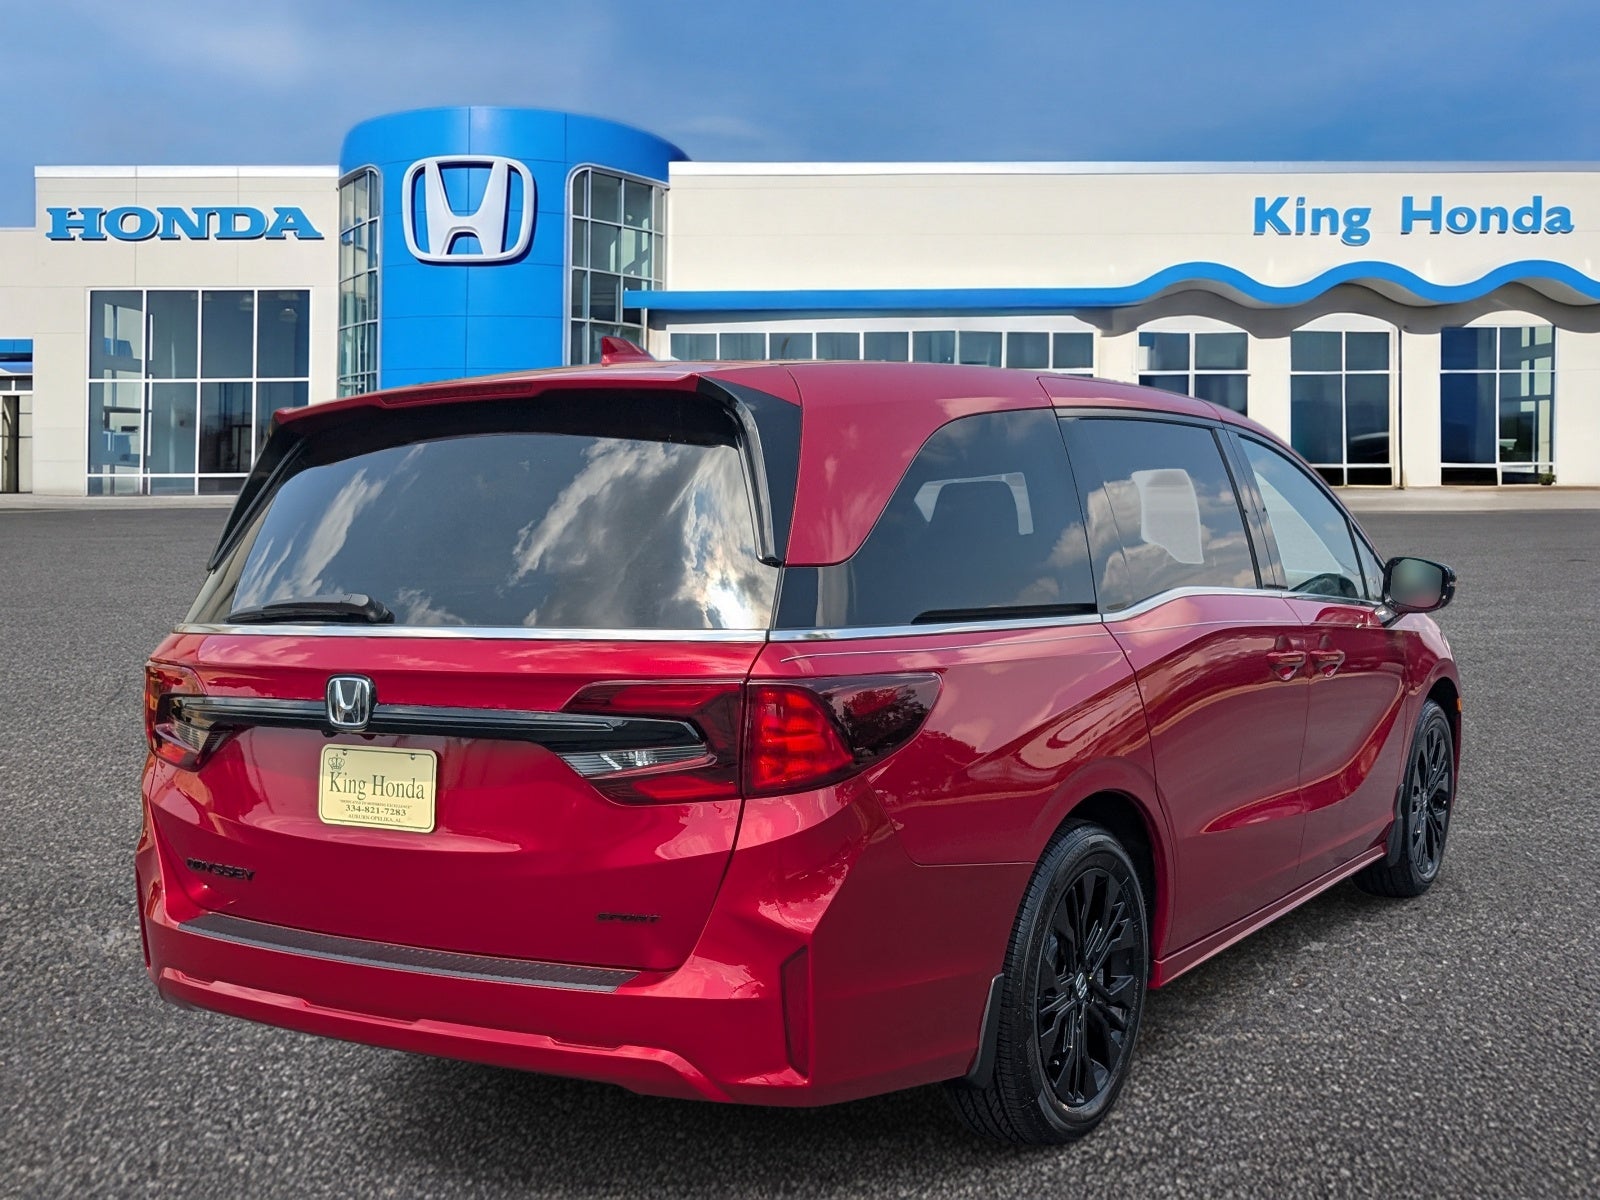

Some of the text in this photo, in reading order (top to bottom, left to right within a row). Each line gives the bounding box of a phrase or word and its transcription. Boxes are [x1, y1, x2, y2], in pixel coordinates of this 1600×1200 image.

[46, 206, 325, 241] HONDA
[1253, 195, 1575, 246] King Honda
[329, 771, 425, 801] King Honda
[345, 804, 407, 816] 334-821-7283
[186, 857, 256, 881] ODYSSEY
[597, 911, 661, 923] SPORT
